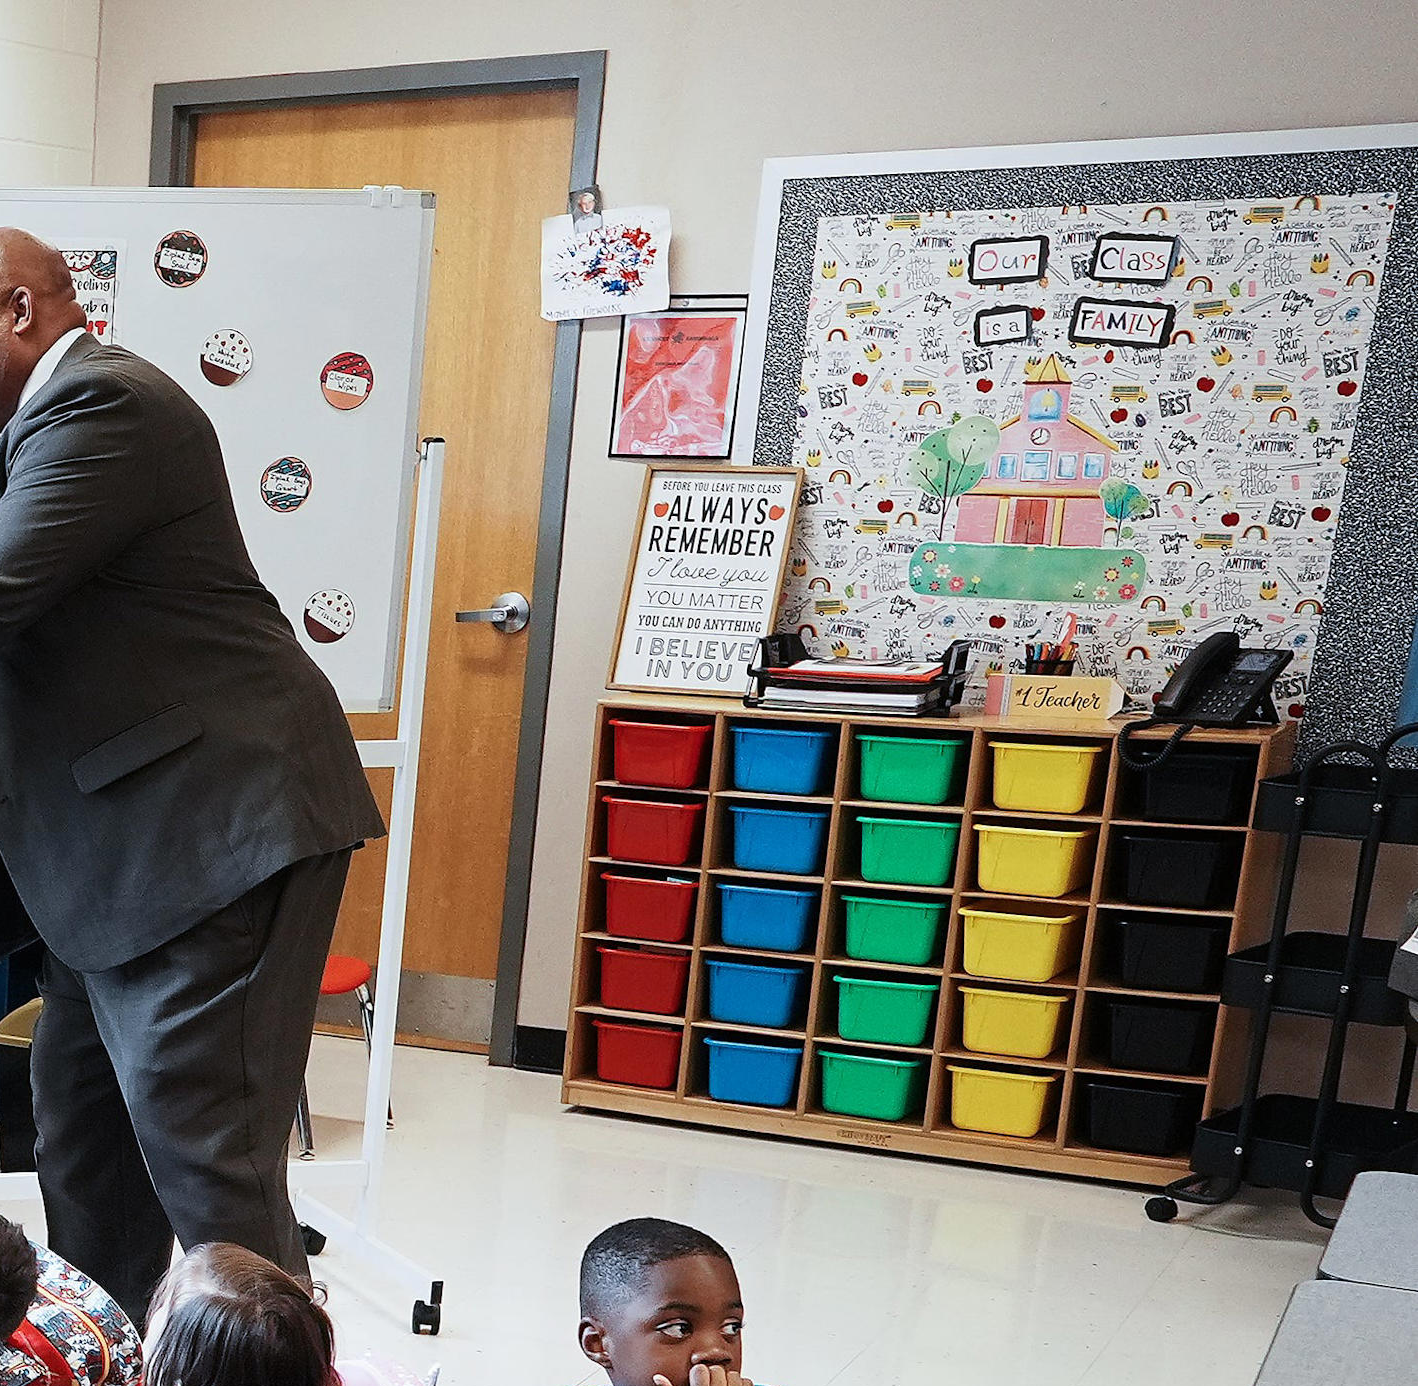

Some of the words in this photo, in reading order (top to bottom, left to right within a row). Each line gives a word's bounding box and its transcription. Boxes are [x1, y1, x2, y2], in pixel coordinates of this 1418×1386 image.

[1274, 230, 1319, 244] ANYTHING
[977, 249, 1037, 272] Our
[1099, 246, 1167, 272] Class
[82, 300, 98, 314] ab
[101, 302, 109, 313] a
[985, 320, 1001, 336] is
[1009, 321, 1021, 334] a
[1080, 308, 1165, 338] FAMILY
[963, 350, 995, 376] BEST
[1323, 351, 1360, 378] BEST
[818, 387, 849, 410] BEST
[1157, 393, 1192, 418] BEST
[662, 481, 691, 491] BEFORE
[694, 482, 710, 492] YOU
[711, 483, 735, 493] LEAVE
[737, 483, 755, 494] THIS
[757, 484, 782, 494] CLASS
[667, 496, 769, 525] ALWAYS
[1267, 502, 1307, 530] BEST
[648, 525, 775, 557] REMEMBER
[647, 557, 673, 577] I
[671, 558, 720, 580] love
[720, 567, 769, 586] you
[1224, 556, 1268, 572] ANYTHING
[647, 590, 684, 606] YOU
[689, 592, 764, 611] MATTER
[638, 615, 659, 628] YOU
[662, 616, 684, 629] CAN
[687, 617, 701, 629] DO
[703, 618, 762, 634] ANYTHING
[635, 637, 643, 655] I
[649, 638, 755, 661] BELIEVE
[646, 659, 672, 679] IN
[681, 661, 733, 683] YOU
[1014, 685, 1032, 708] #1
[1033, 683, 1102, 713] Teacher
